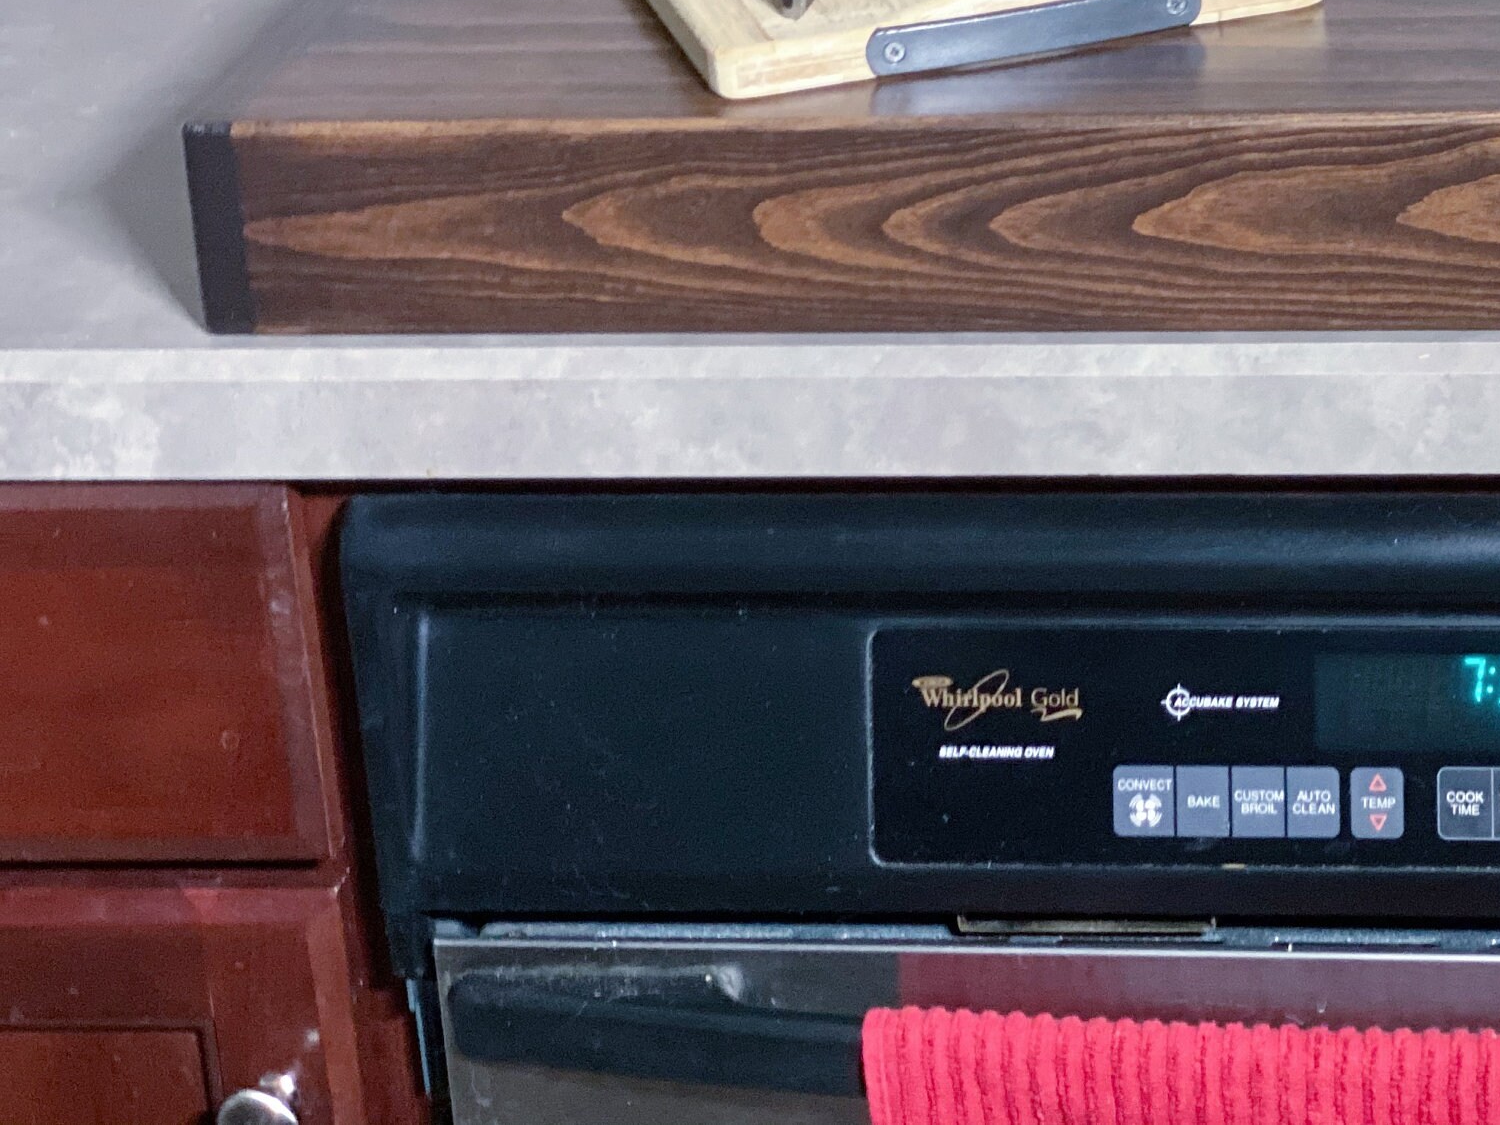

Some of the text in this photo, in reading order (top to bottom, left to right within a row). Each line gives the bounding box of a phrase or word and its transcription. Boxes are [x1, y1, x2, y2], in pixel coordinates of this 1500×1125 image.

[914, 678, 1079, 712] Whirlpool Gold
[1174, 696, 1280, 708] ACCUBAKE SYSTEM
[938, 744, 1055, 759] SELF-CLEANING OVEN
[1117, 779, 1172, 791] CONVECT
[1187, 795, 1220, 808] BAKE
[1234, 790, 1284, 803] CUSTOM
[1297, 790, 1331, 803] AUTO
[1361, 797, 1396, 809] TEMP
[1446, 790, 1484, 803] COOK
[1241, 803, 1278, 815] BROIL
[1292, 803, 1335, 815] CLEAN
[1451, 803, 1480, 816] TIME
